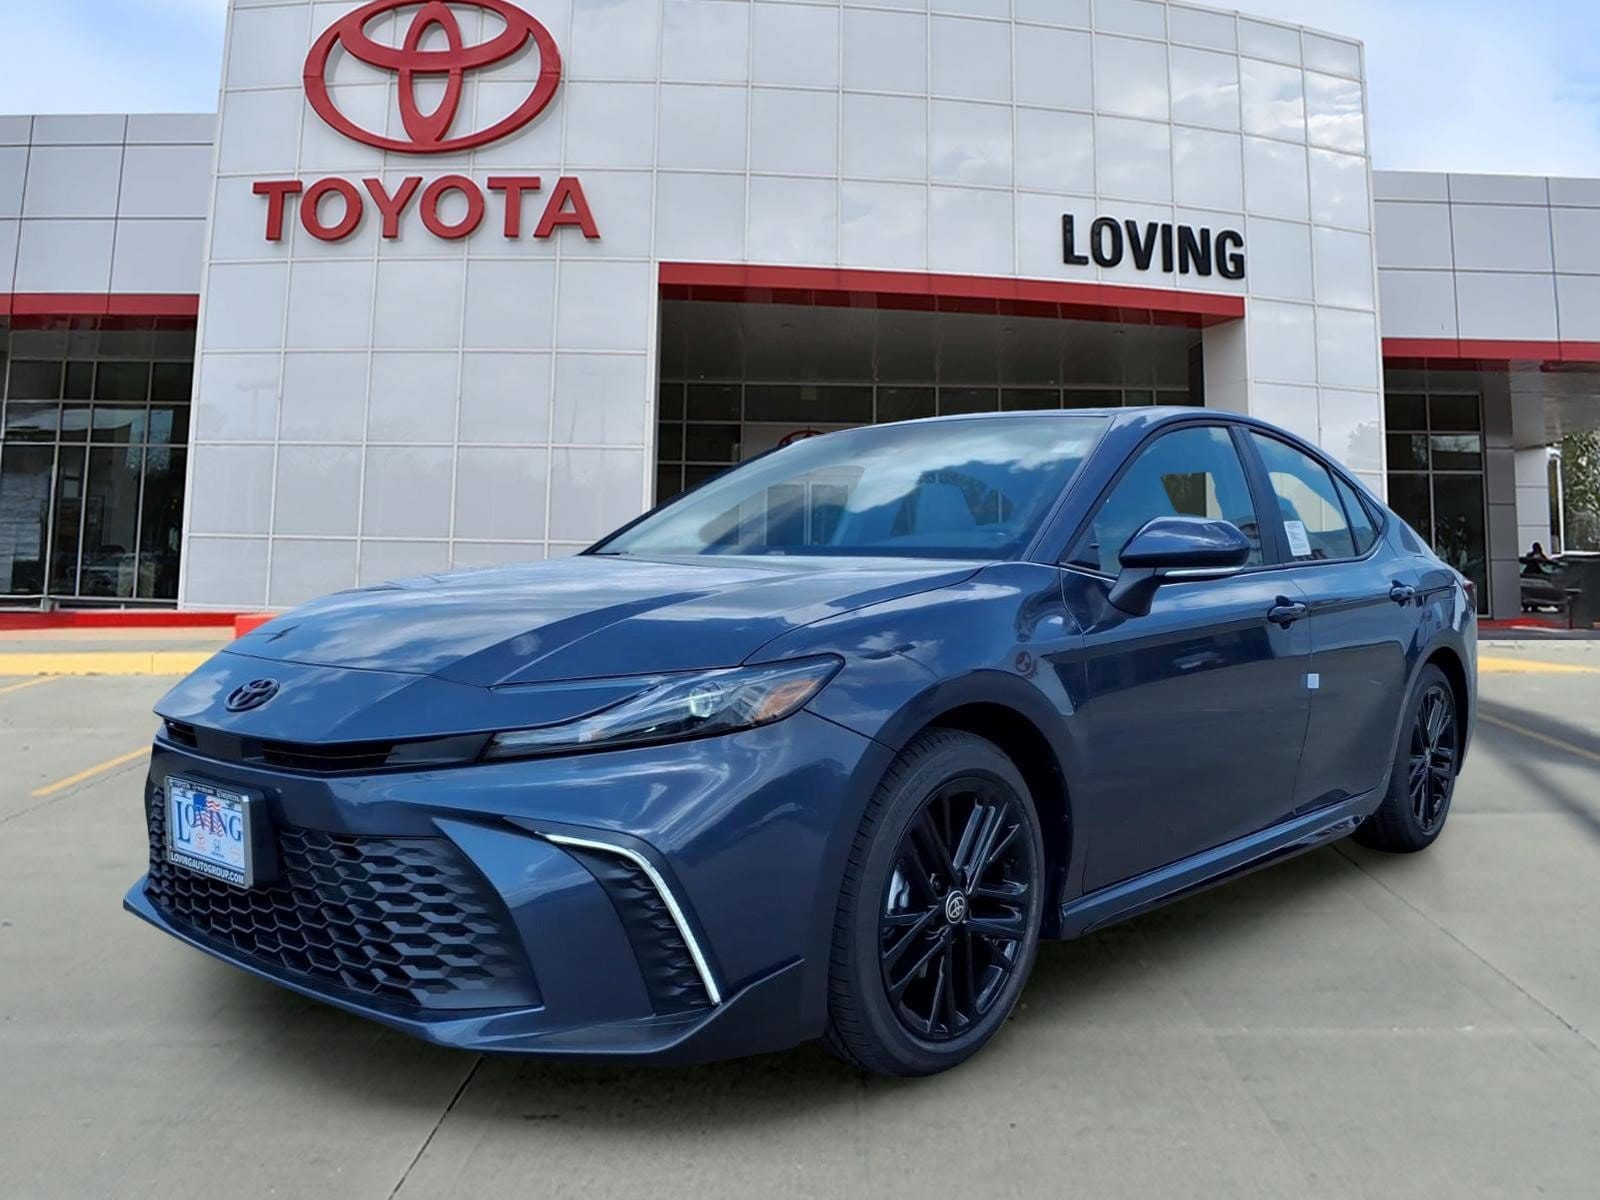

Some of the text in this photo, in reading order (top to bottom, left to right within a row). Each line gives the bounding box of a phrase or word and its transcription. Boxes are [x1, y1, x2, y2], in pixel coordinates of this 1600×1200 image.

[252, 174, 600, 241] TOYOTA
[1062, 213, 1245, 279] LOVING
[175, 800, 242, 843] LOVING
[170, 851, 244, 883] LOVINGAUTOGROUP.COM
